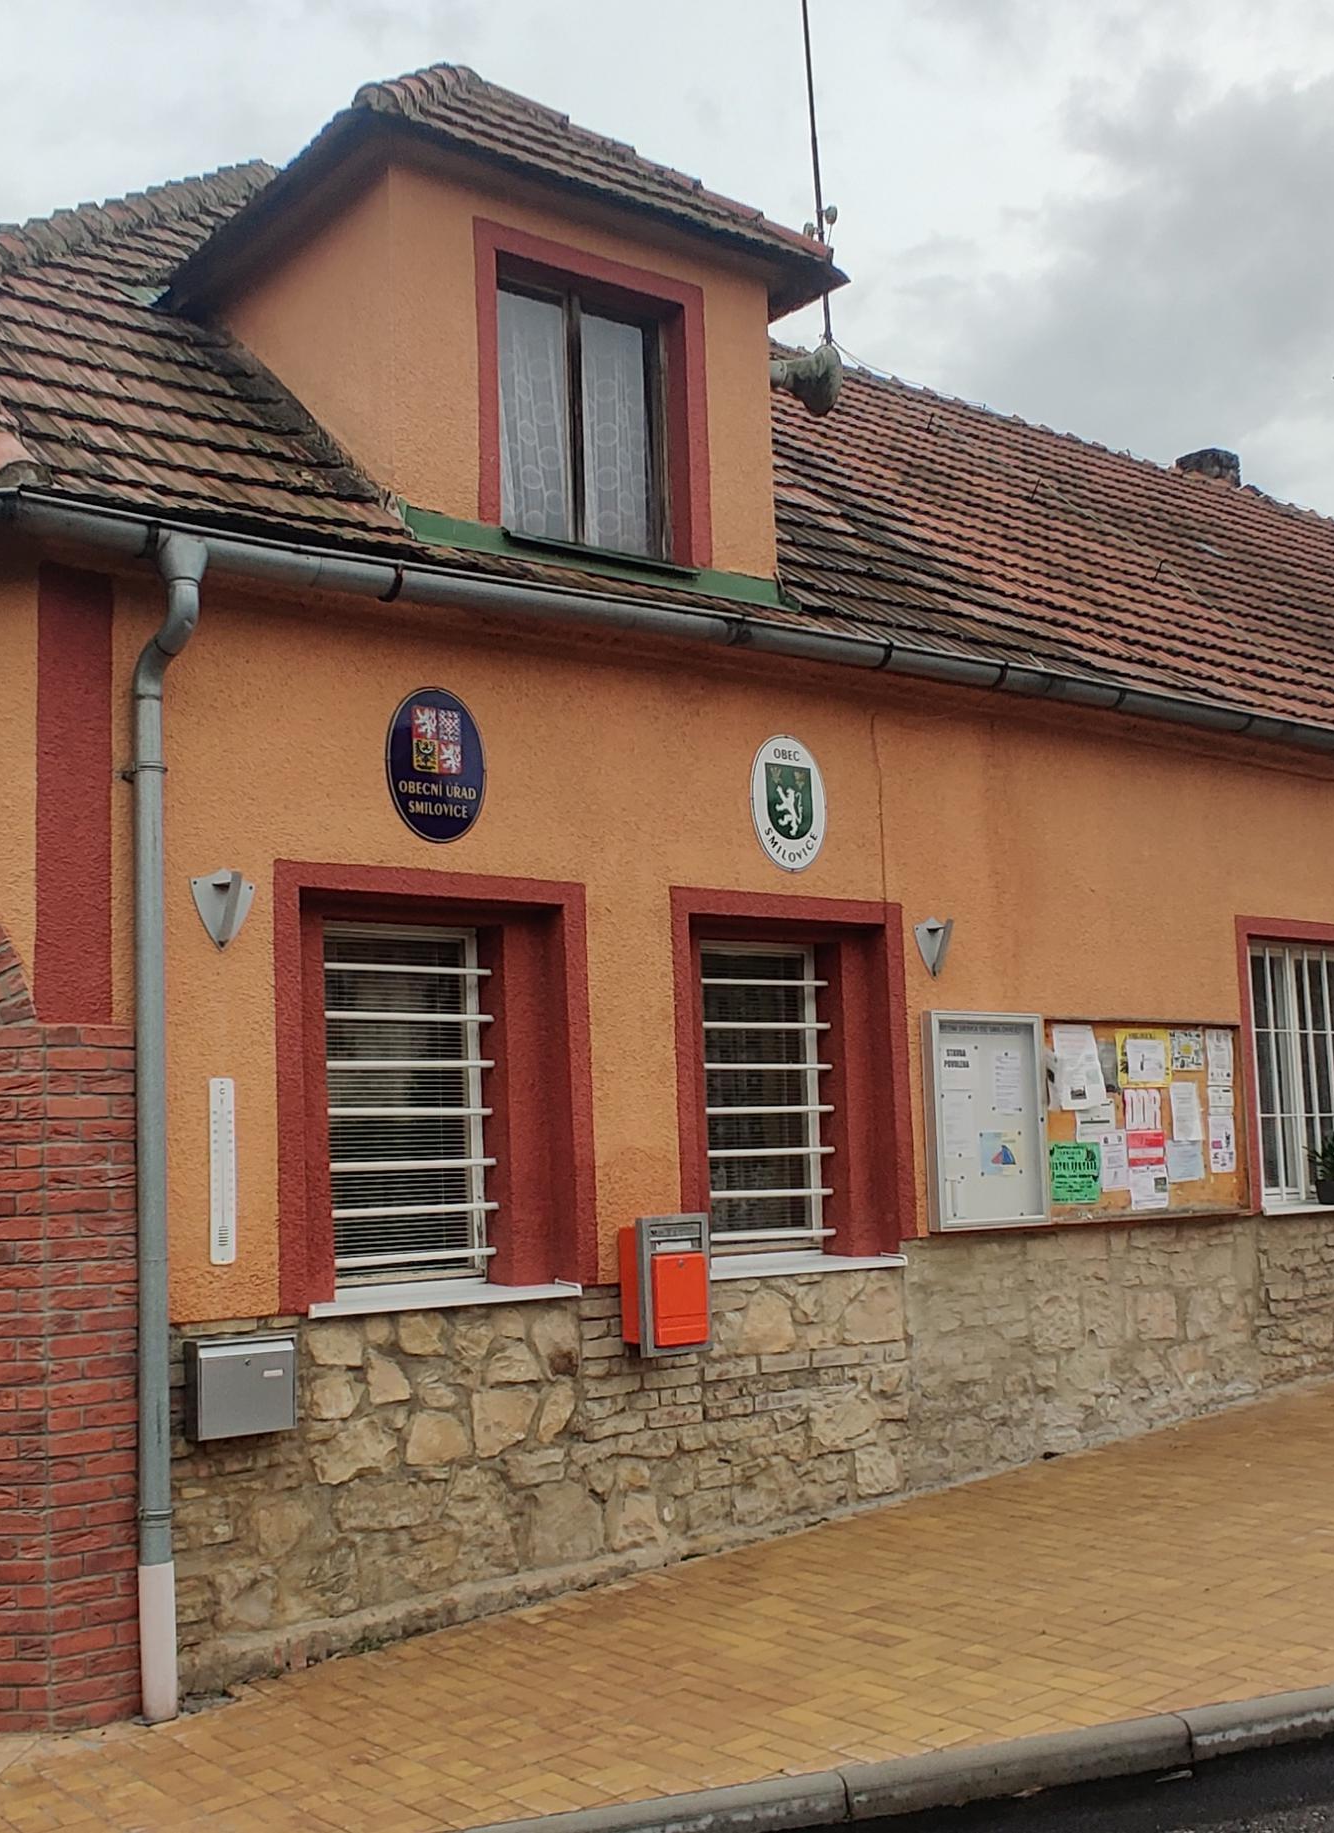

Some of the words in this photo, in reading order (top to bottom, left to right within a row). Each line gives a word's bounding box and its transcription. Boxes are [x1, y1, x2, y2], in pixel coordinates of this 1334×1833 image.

[773, 748, 800, 761] OBEC
[398, 780, 443, 797] OBECNÍ
[446, 782, 477, 800] ÚŘAD
[408, 801, 468, 818] SMILOVICE
[764, 827, 819, 863] SMILOVICE
